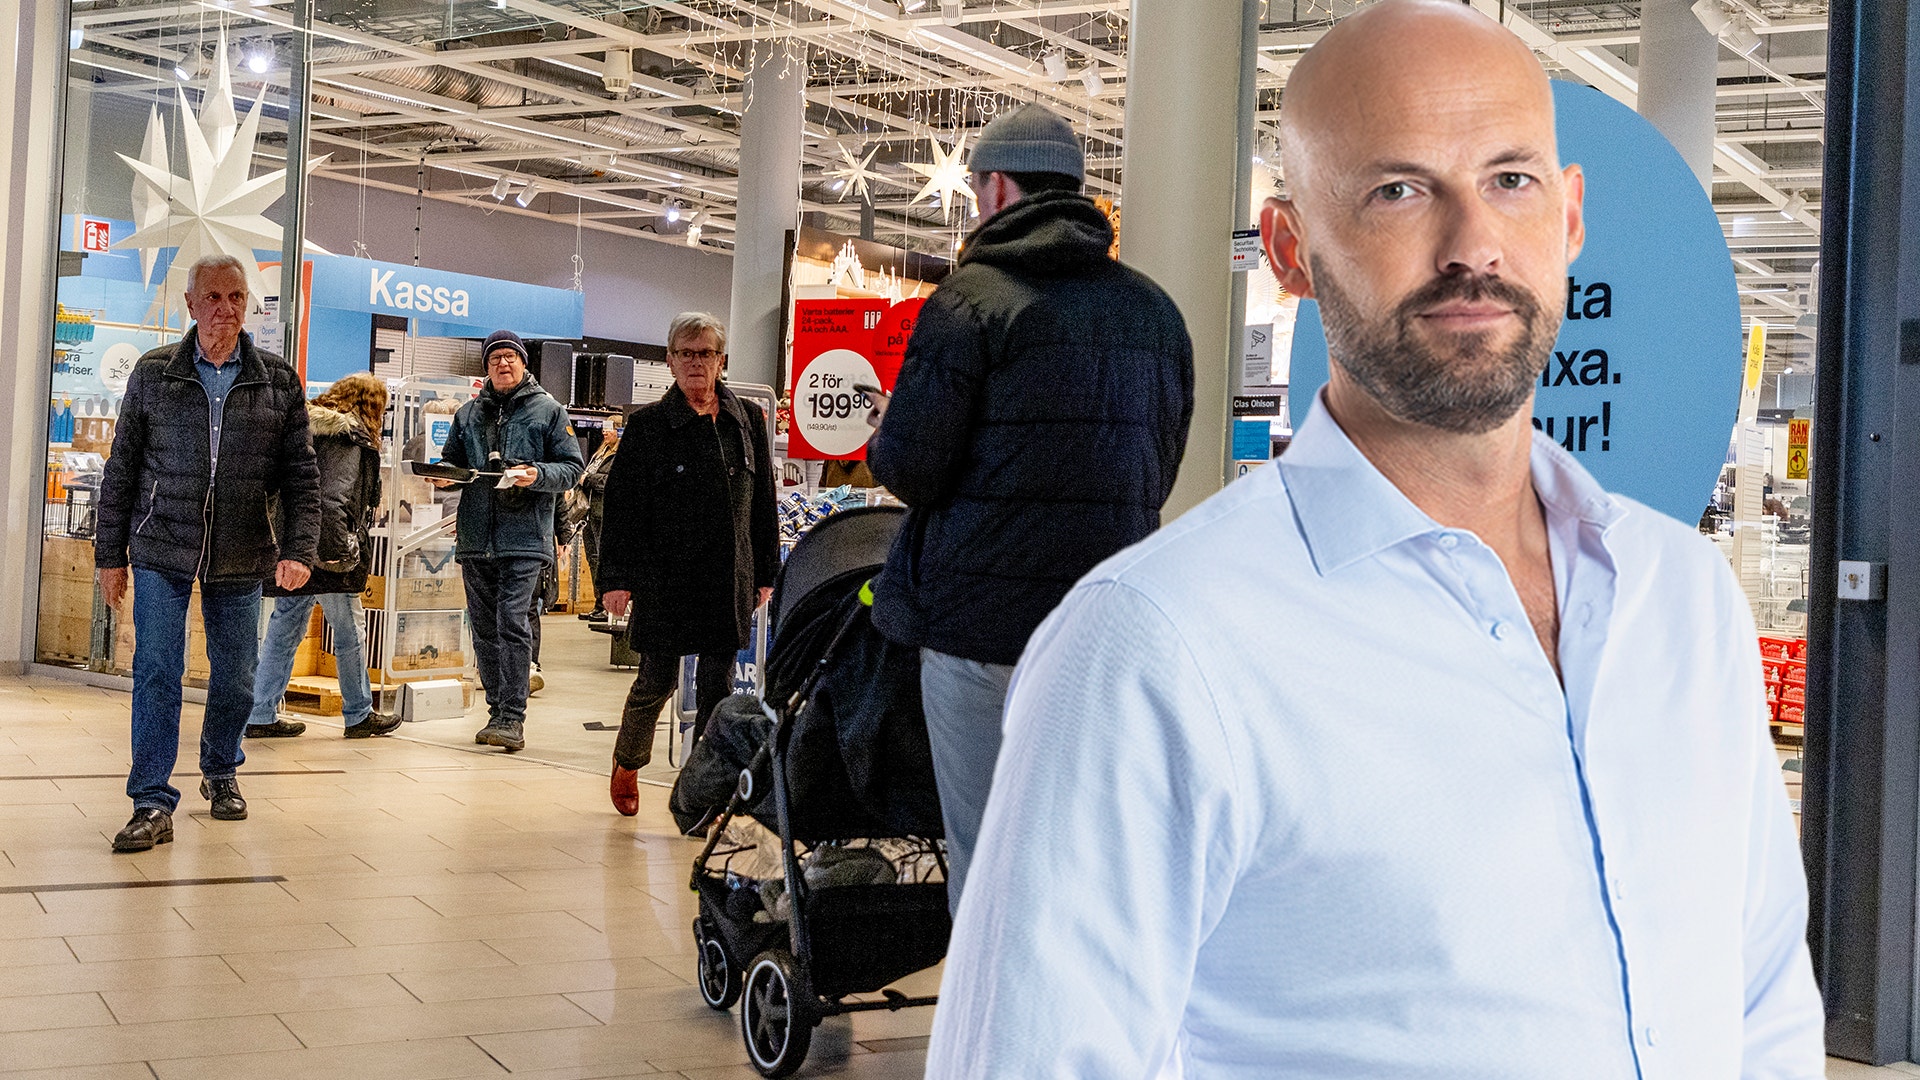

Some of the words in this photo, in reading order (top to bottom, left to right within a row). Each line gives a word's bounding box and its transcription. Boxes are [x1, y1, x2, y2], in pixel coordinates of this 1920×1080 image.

[369, 267, 470, 317] Kassa
[801, 308, 822, 316] Varta
[823, 308, 855, 316] batterier
[801, 316, 835, 325] 24-pack,
[801, 325, 813, 333] AA
[814, 325, 829, 334] och
[887, 332, 904, 348] på
[809, 373, 819, 388] 2
[822, 373, 843, 389] för
[1234, 400, 1249, 408] Clas
[1251, 399, 1275, 407] Ohlson
[1790, 420, 1808, 435] RÅN
